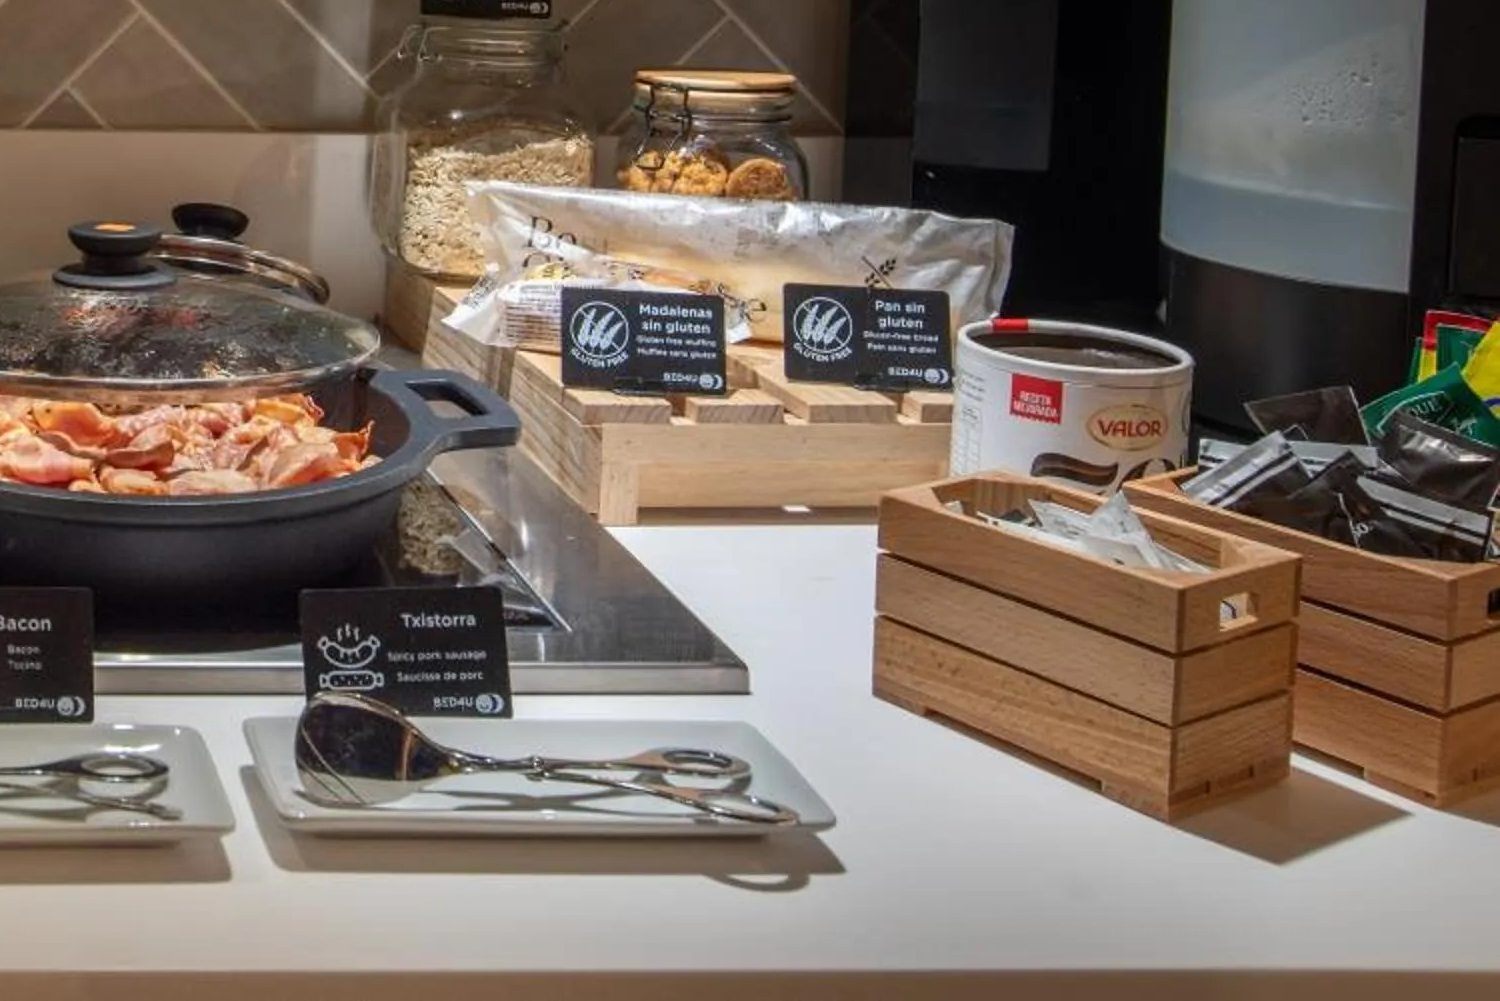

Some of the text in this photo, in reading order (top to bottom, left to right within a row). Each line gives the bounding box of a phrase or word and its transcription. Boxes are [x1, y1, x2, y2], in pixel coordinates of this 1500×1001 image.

[638, 303, 713, 319] Madalenas
[875, 300, 925, 314] Pan sin
[641, 320, 711, 335] sin gluten
[878, 317, 924, 330] gluten
[1096, 418, 1164, 438] VALOR
[400, 612, 477, 628] Txistorra
[7, 644, 40, 655] Bacon
